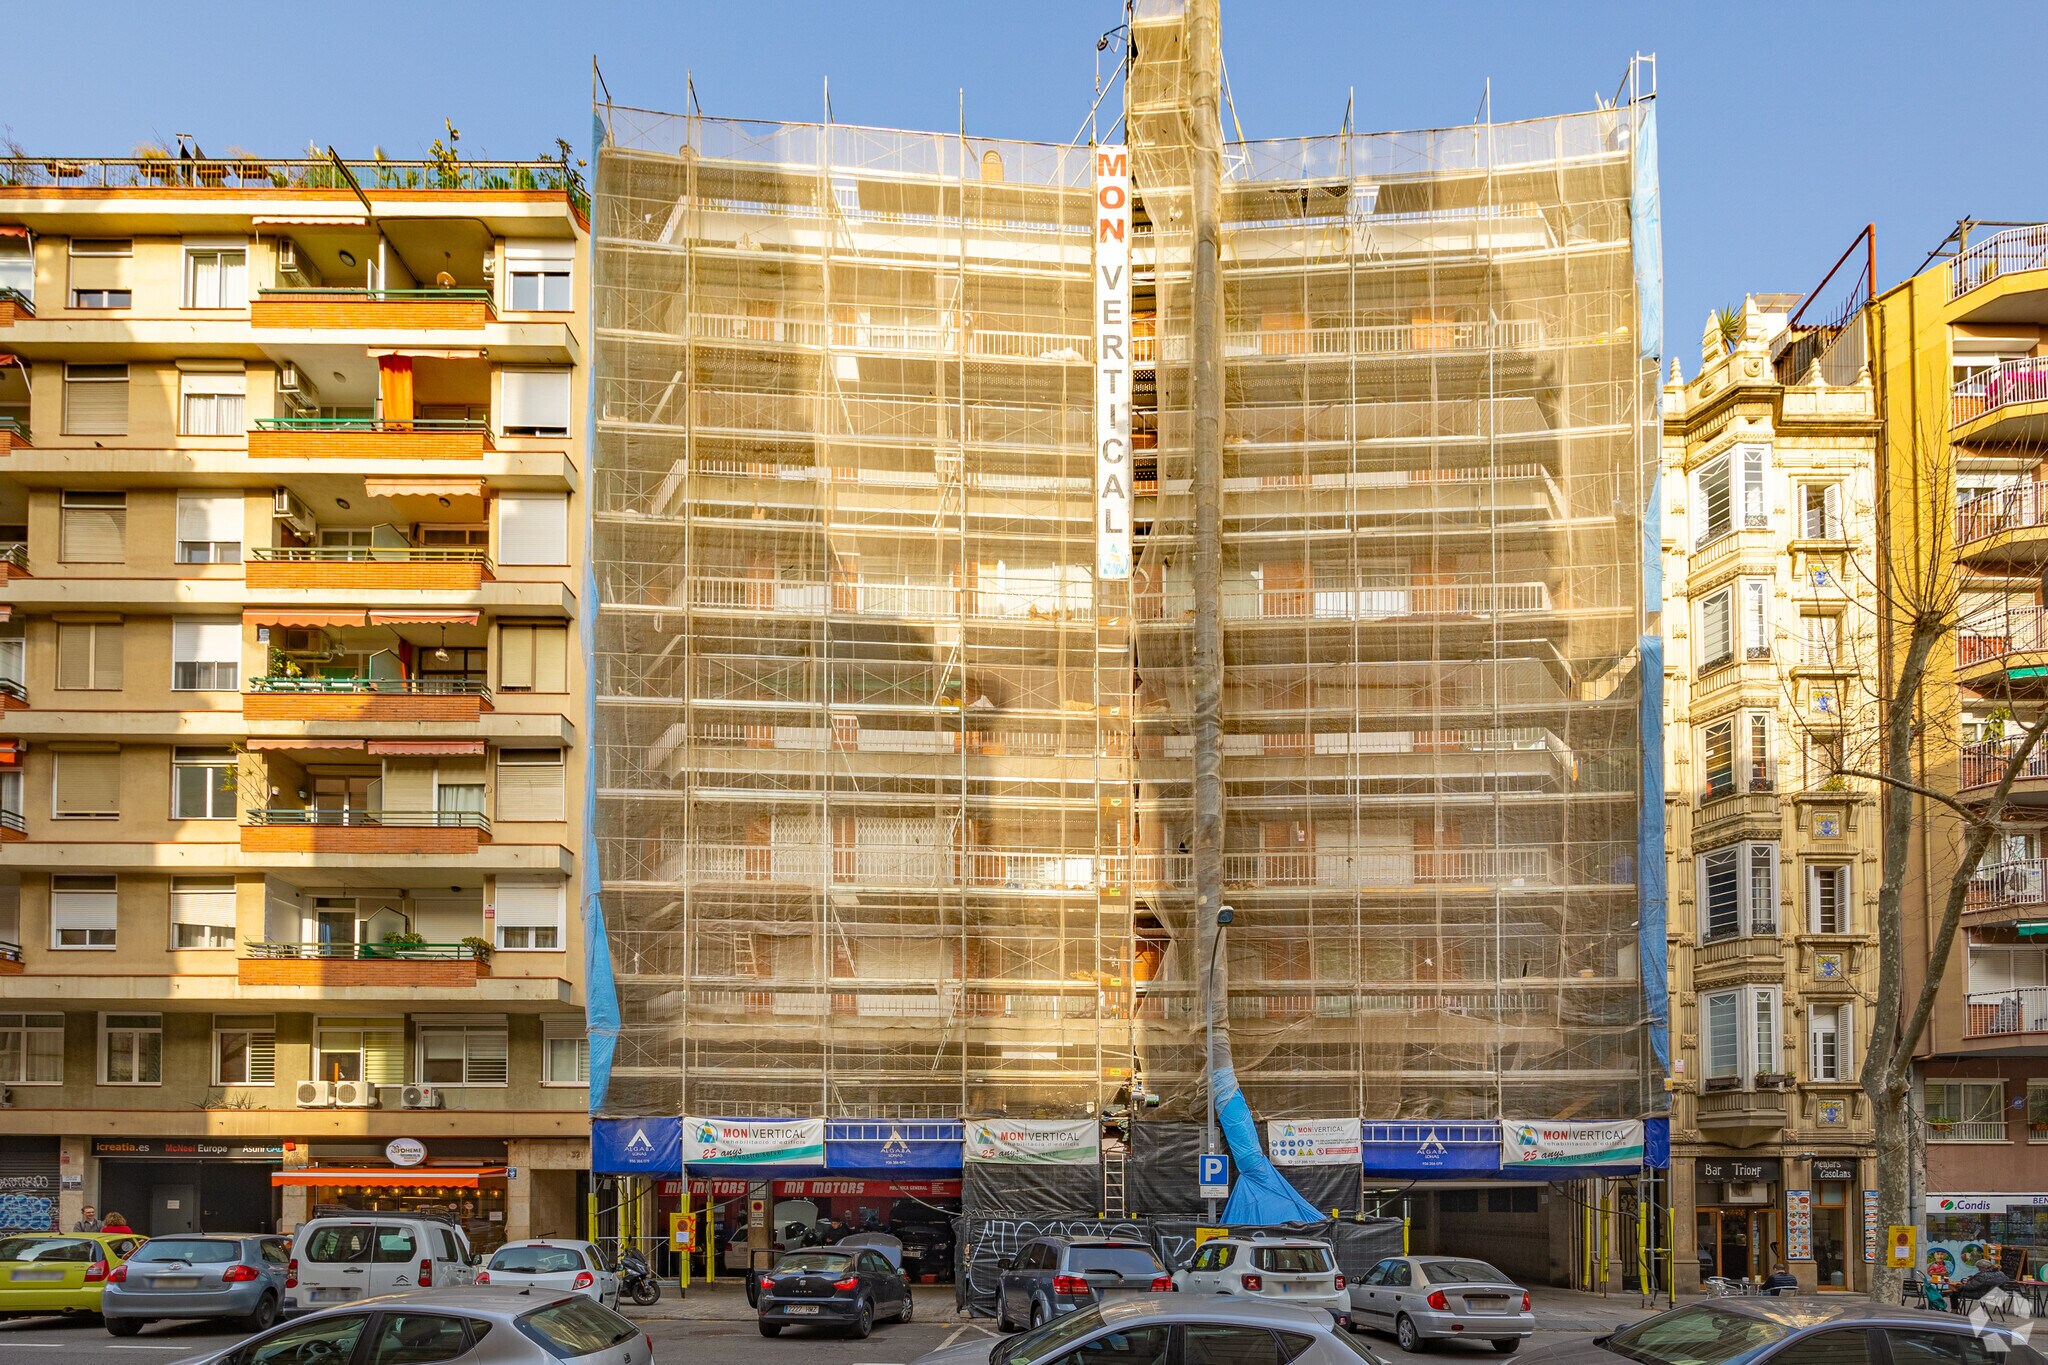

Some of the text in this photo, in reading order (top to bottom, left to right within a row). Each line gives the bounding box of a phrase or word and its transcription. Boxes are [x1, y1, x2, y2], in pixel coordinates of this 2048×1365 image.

[1097, 153, 1127, 243] MON
[1099, 265, 1125, 533] VERTICAL
[723, 1128, 806, 1139] MON VERTICAL
[1000, 1131, 1079, 1141] MON VERTICAL
[1543, 1130, 1626, 1140] MON VERTICAL
[96, 1142, 150, 1152] icreatia.es
[165, 1143, 228, 1154] McNeel Europe
[242, 1144, 265, 1153] Asuni
[702, 1147, 743, 1160] 25 anys
[981, 1148, 995, 1159] 25
[1523, 1149, 1565, 1162] 25 anys
[1205, 1158, 1222, 1182] P
[1705, 1163, 1722, 1176] Bar
[783, 1181, 865, 1194] MH MOTORS
[1957, 1200, 1990, 1210] Condis
